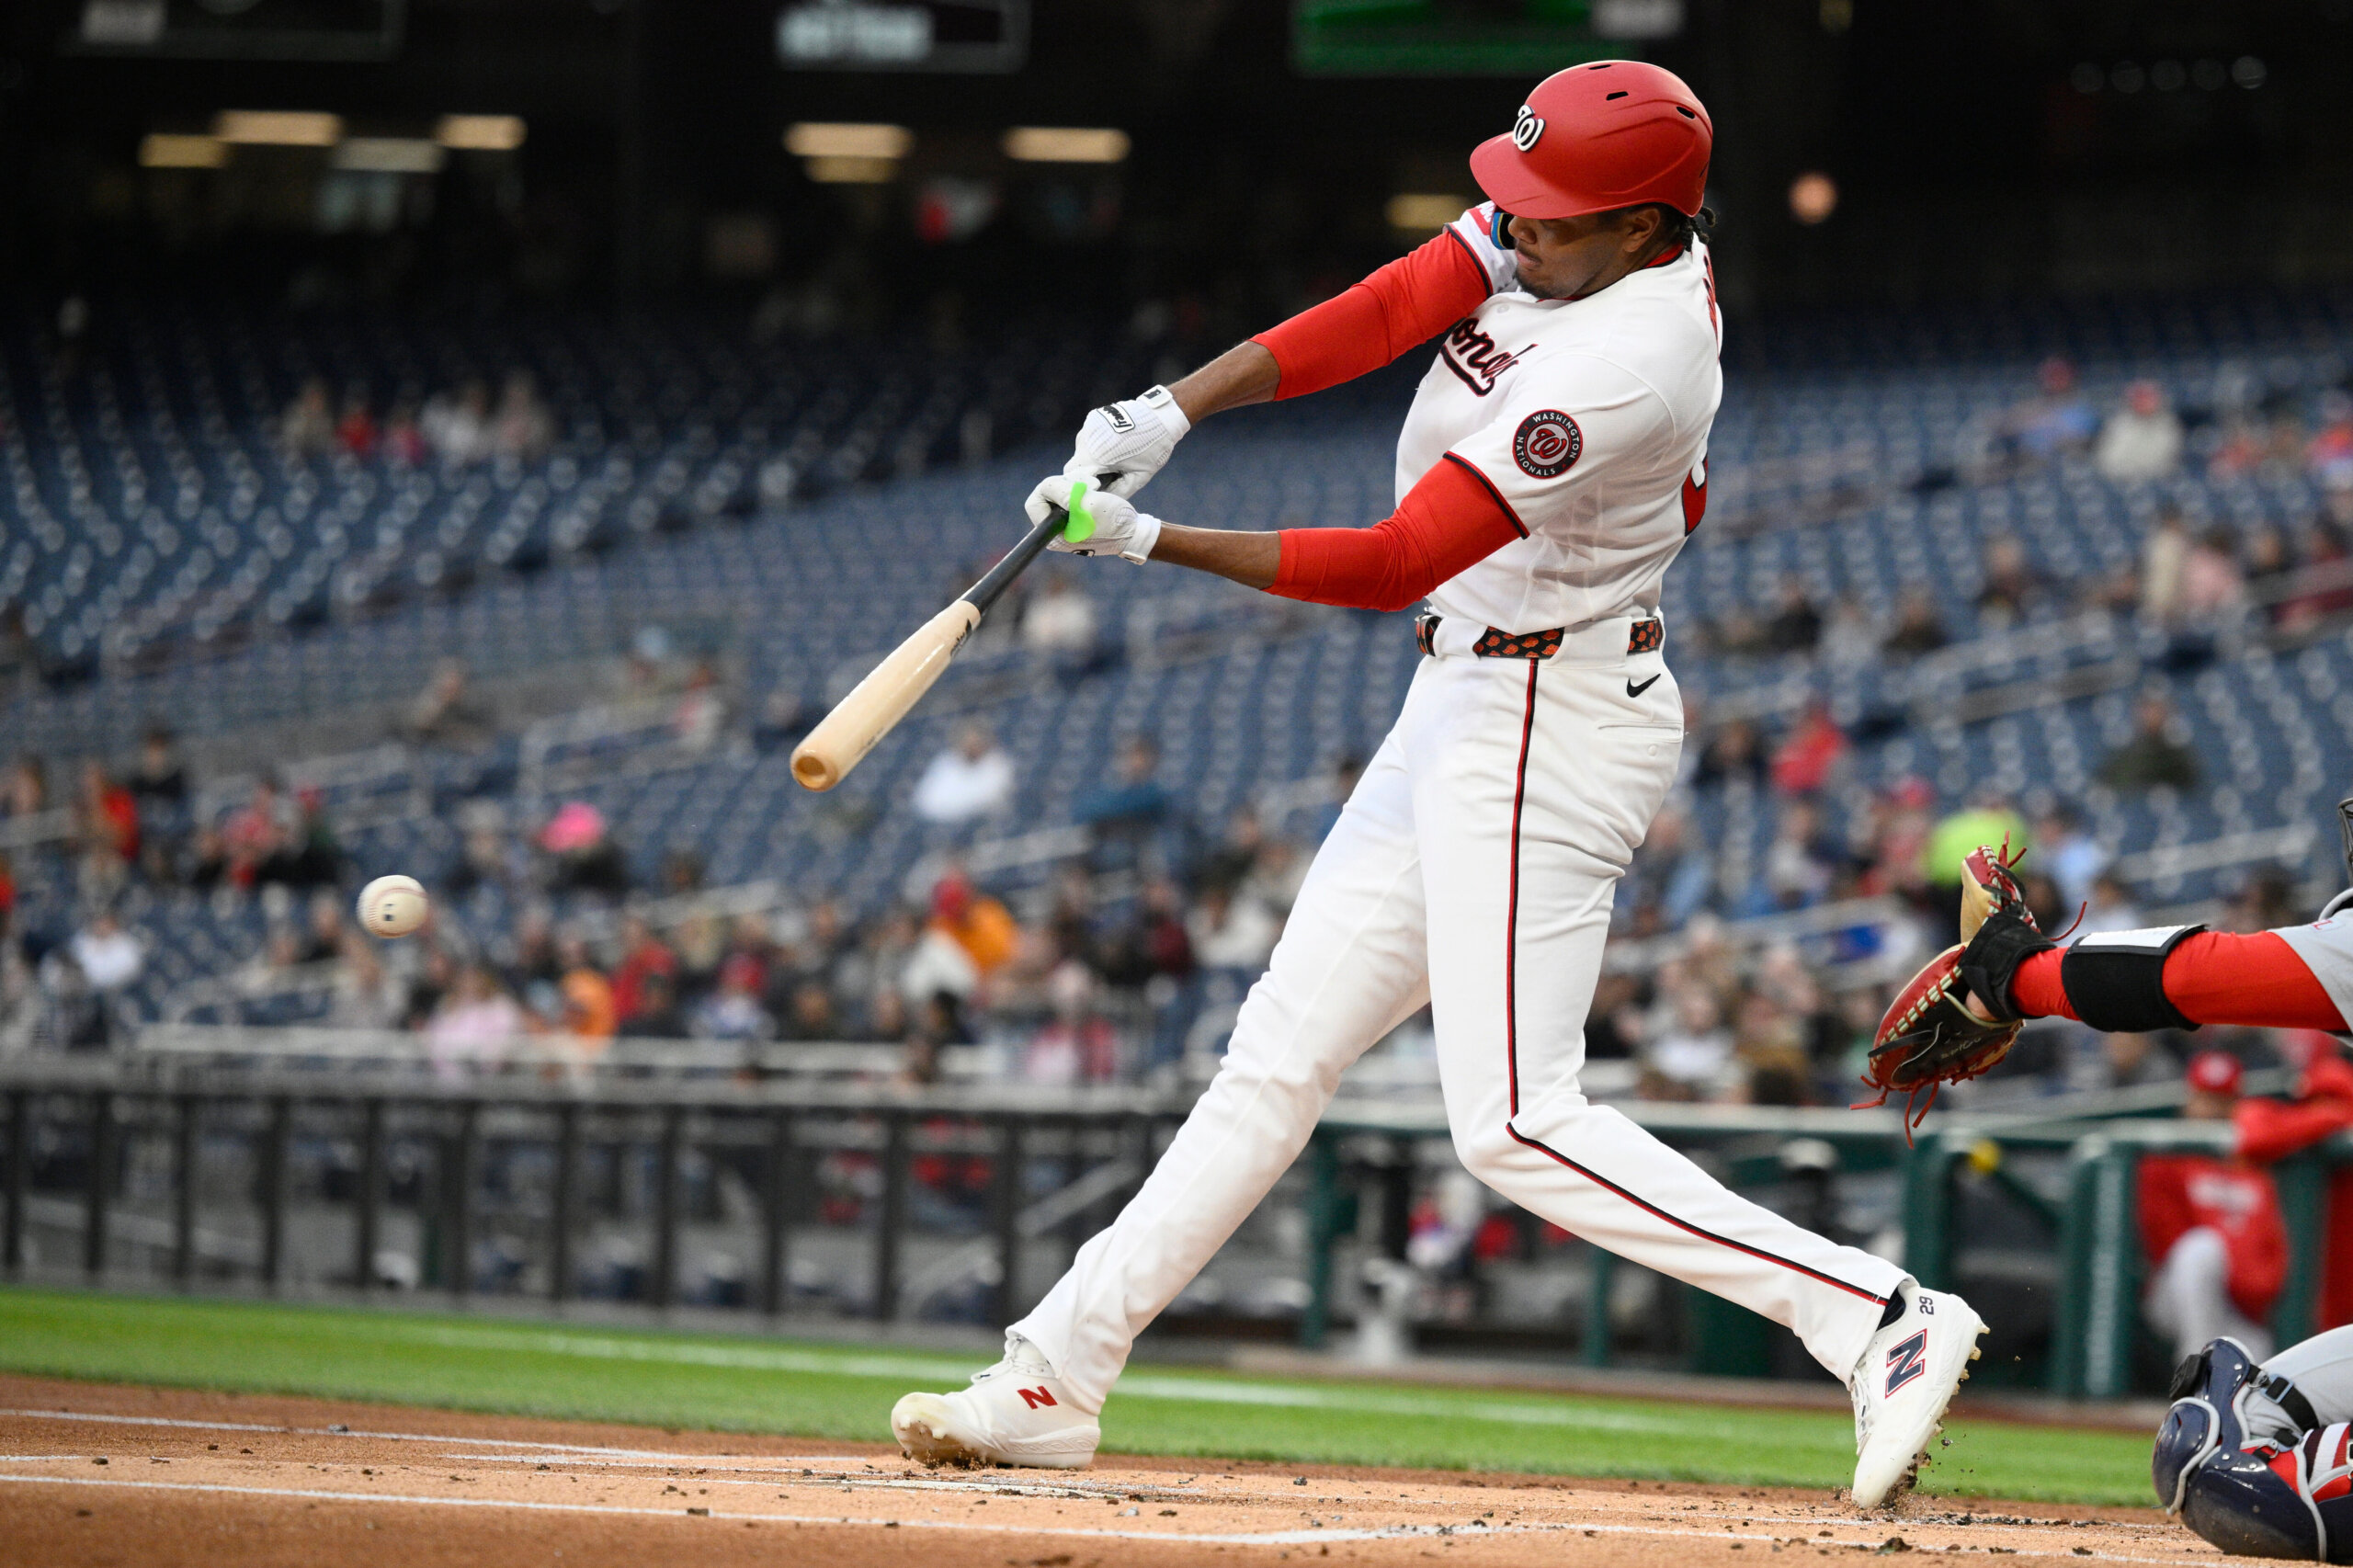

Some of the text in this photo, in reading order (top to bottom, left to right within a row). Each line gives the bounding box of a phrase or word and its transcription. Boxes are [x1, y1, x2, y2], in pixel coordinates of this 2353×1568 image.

[1513, 105, 1546, 153] W
[1529, 428, 1567, 460] W
[1532, 412, 1580, 459] WASHINGTON
[1517, 436, 1556, 476] NATIONALS
[1919, 1295, 1934, 1315] 29
[1885, 1328, 1927, 1399] N
[1017, 1385, 1058, 1410] N
